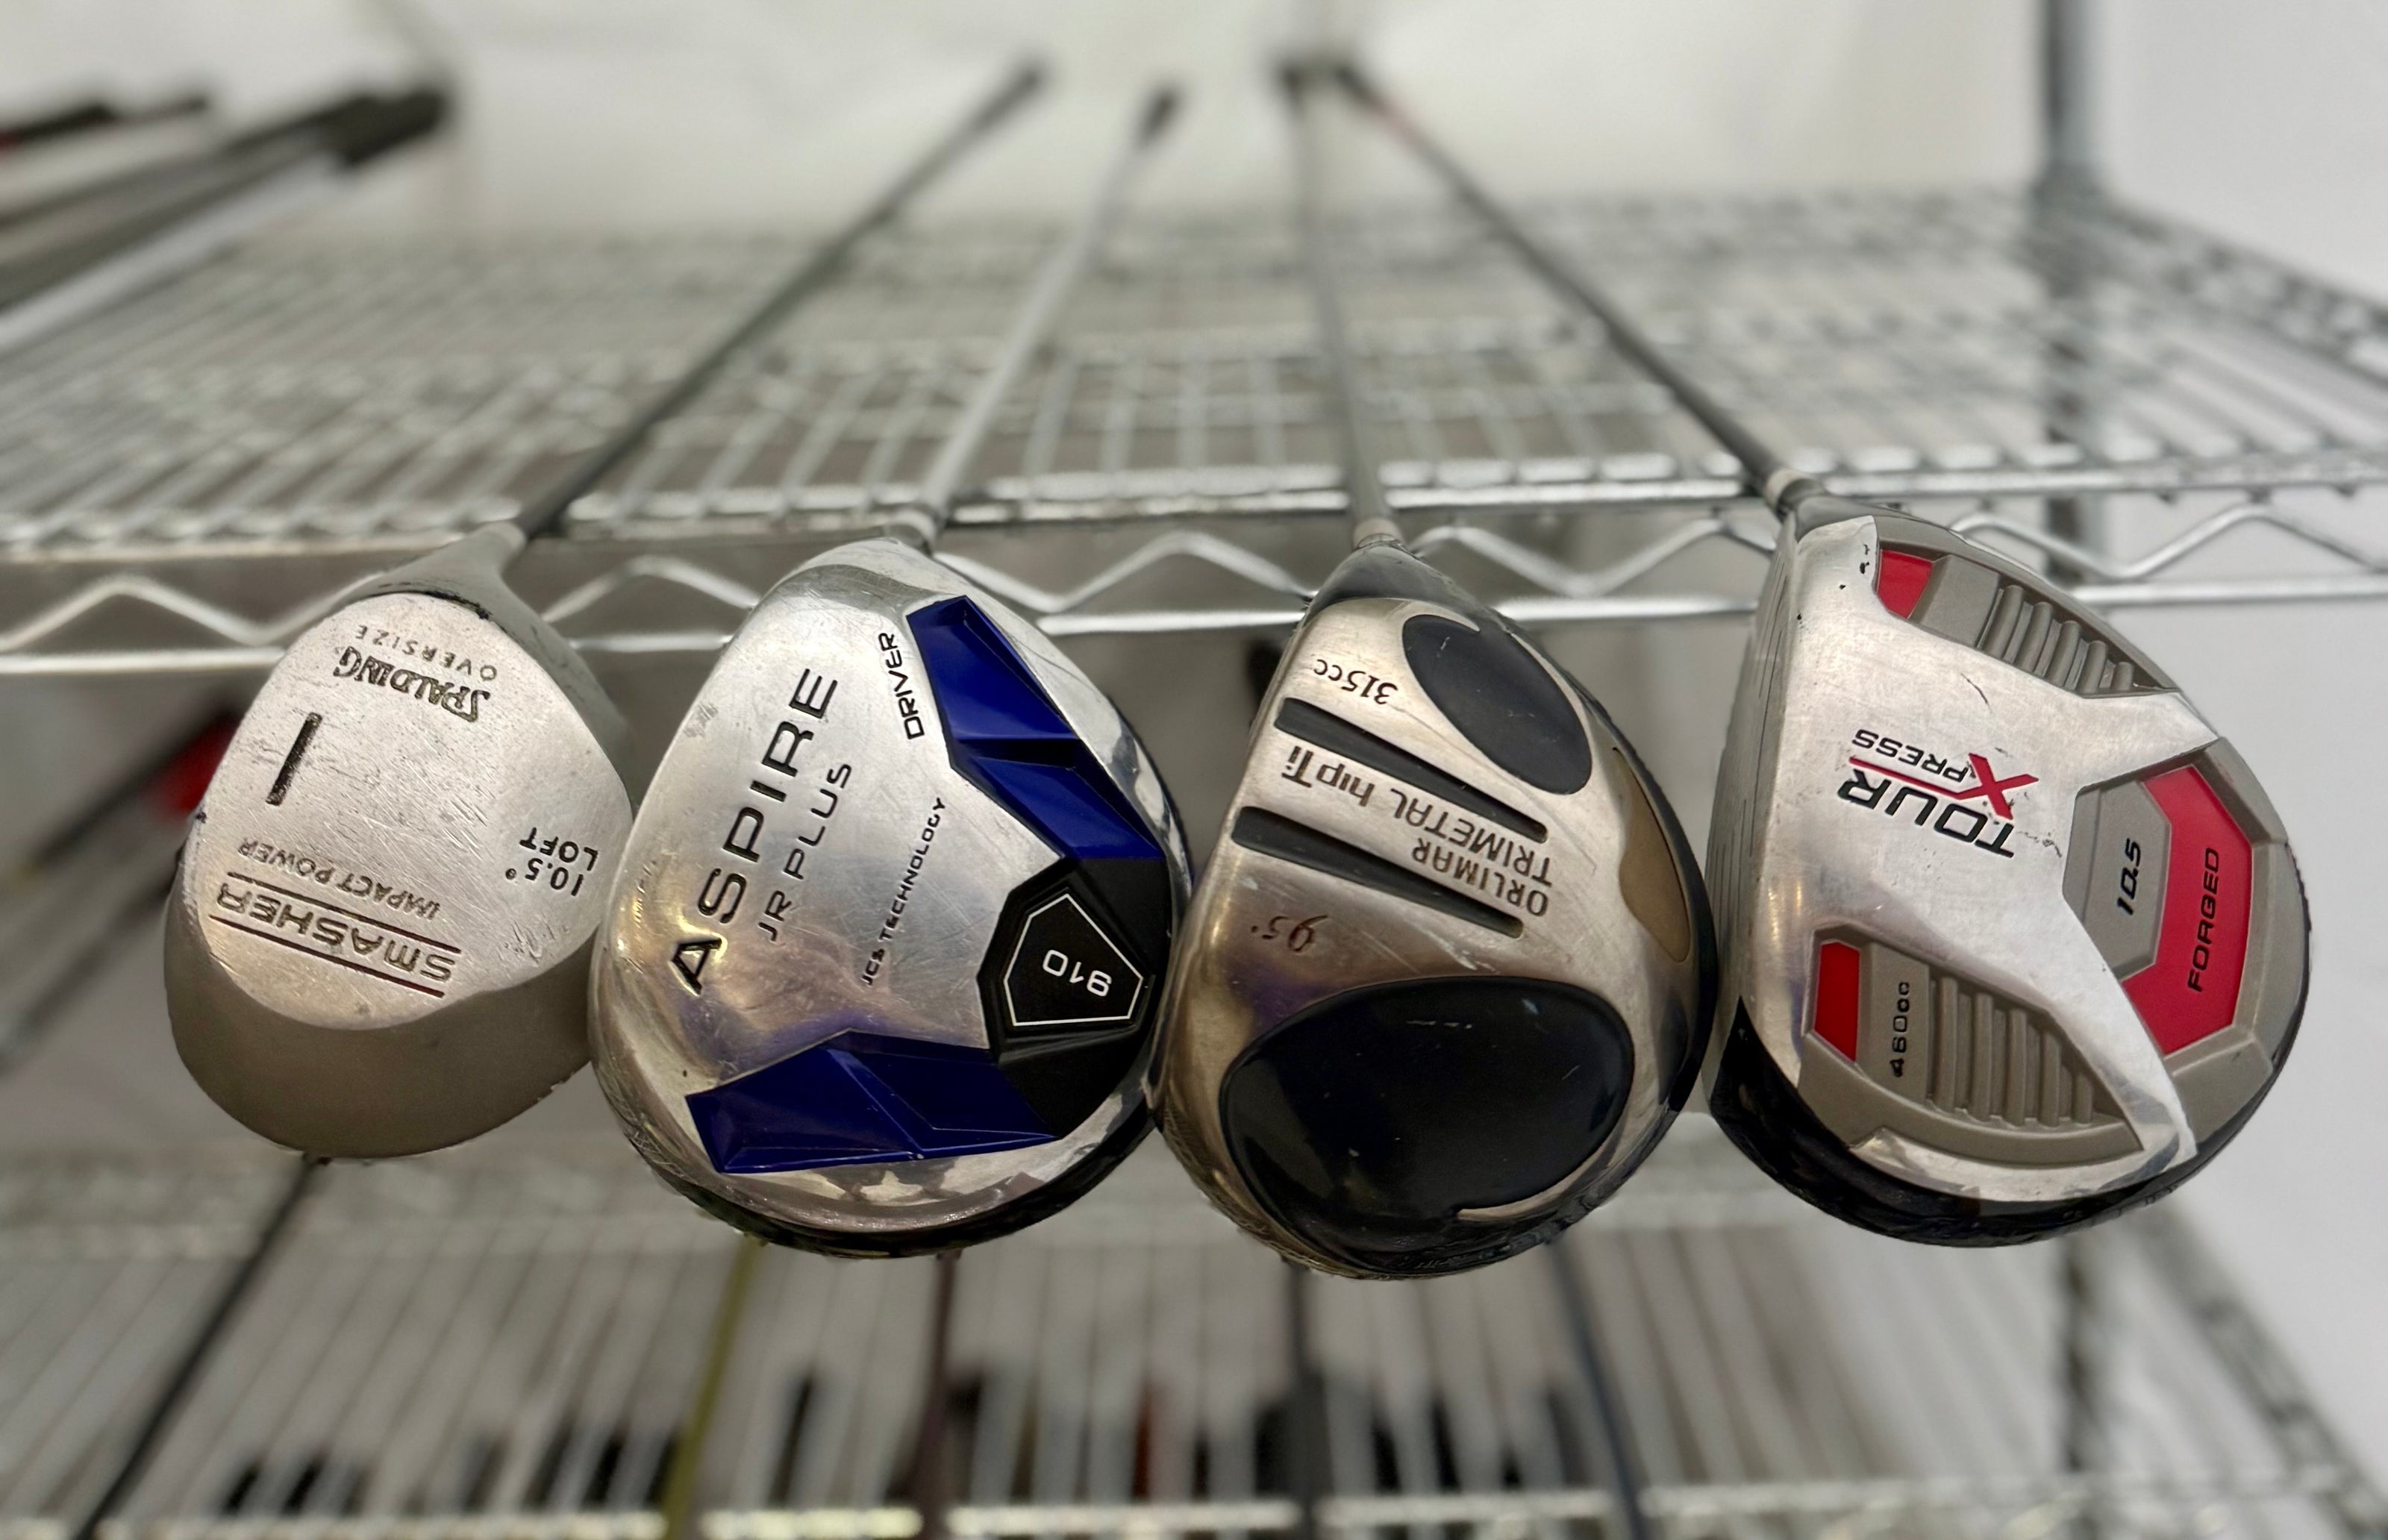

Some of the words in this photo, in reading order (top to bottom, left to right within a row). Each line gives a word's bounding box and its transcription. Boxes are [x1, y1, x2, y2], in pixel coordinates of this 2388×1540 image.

[334, 647, 490, 722] SPALDING
[357, 625, 497, 680] OVERSIZE
[879, 632, 925, 739] DRIVER
[1313, 658, 1398, 705] 315cc
[266, 712, 322, 805] 1
[519, 827, 598, 871] LOFT
[672, 669, 839, 995] ASPIRE
[759, 891, 792, 942] JR
[783, 764, 851, 880] PLUS
[1390, 789, 1553, 887] TRIMETAL
[1837, 769, 2015, 858] TOUR
[238, 836, 334, 886] POWER
[335, 866, 440, 920] IMPACT
[879, 798, 945, 942] TECHNOLOGY
[1413, 839, 1548, 917] ORLIMAR
[2117, 837, 2141, 916] 10.5
[216, 883, 455, 981] SMASHER
[2188, 848, 2219, 992] FORGED
[1043, 950, 1111, 997] 910
[1890, 982, 1911, 1077] 460cc
